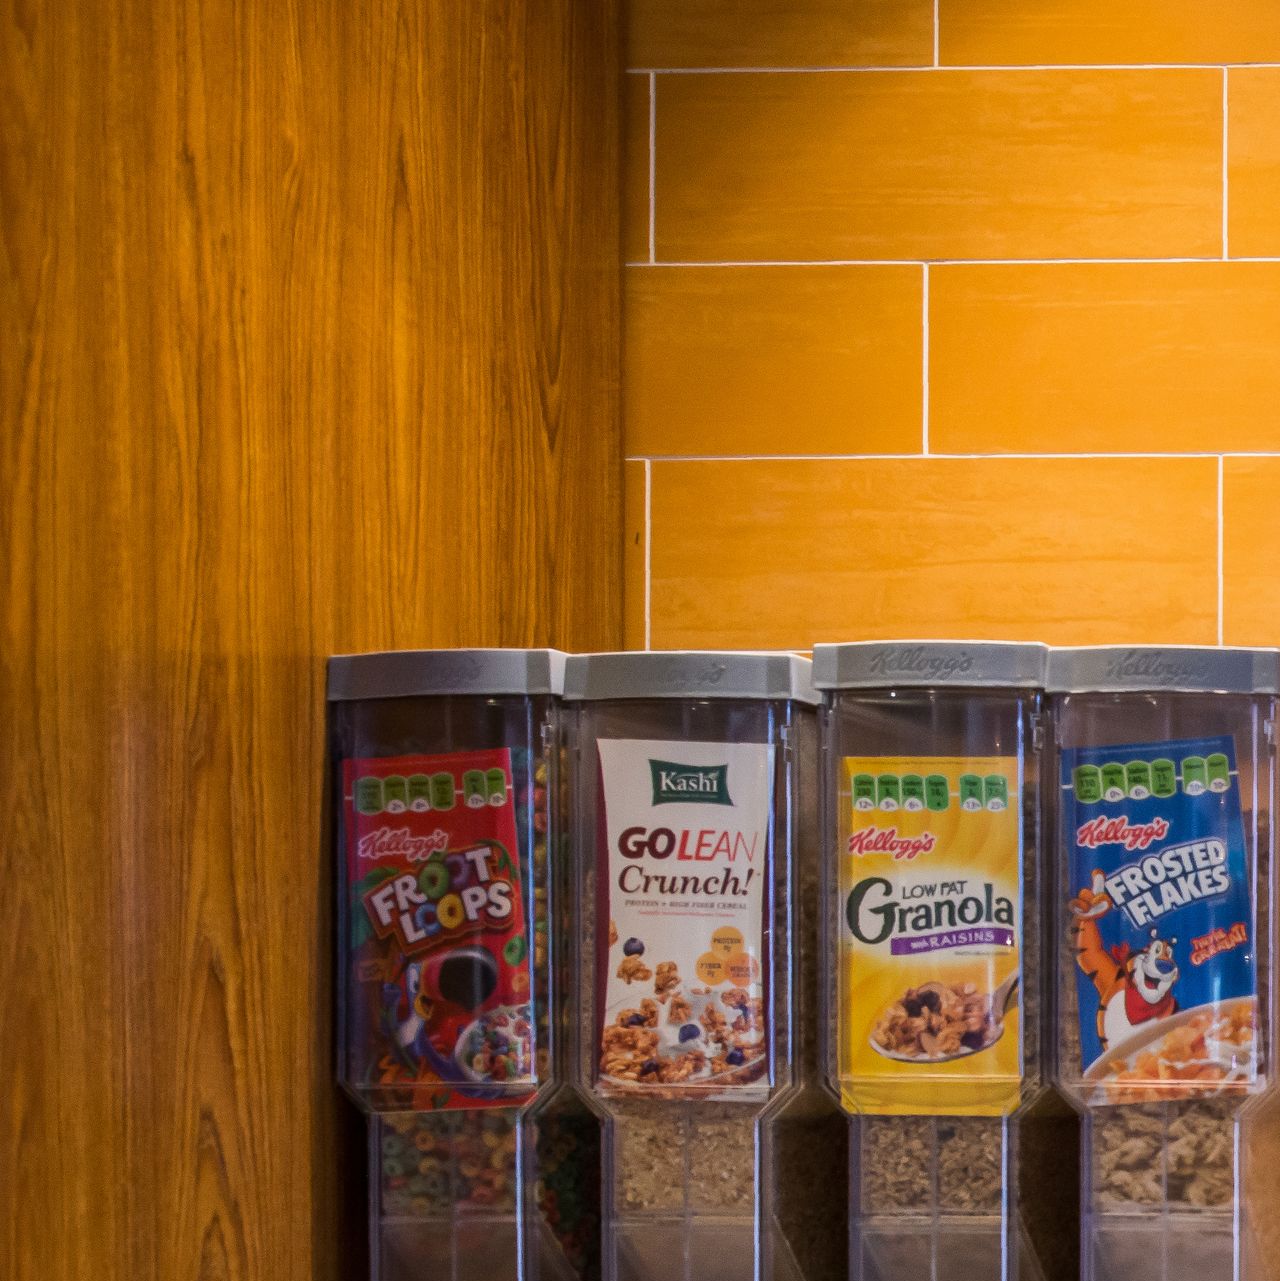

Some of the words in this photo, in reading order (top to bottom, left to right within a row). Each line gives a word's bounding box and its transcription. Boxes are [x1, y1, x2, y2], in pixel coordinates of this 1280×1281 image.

[659, 770, 720, 793] Kashi
[358, 827, 449, 862] Kellogg's
[849, 826, 935, 860] Kellogg's
[1077, 815, 1170, 850] Kellogg's
[371, 846, 492, 926] FROOT
[618, 864, 754, 896] Crunch!
[902, 885, 936, 900] LOW
[940, 880, 968, 897] FAT
[1104, 840, 1226, 906] FROSTED
[400, 882, 512, 944] LOOPS
[846, 877, 1015, 944] Granola
[1125, 864, 1230, 927] FLAKES
[929, 931, 995, 948] RAISINS
